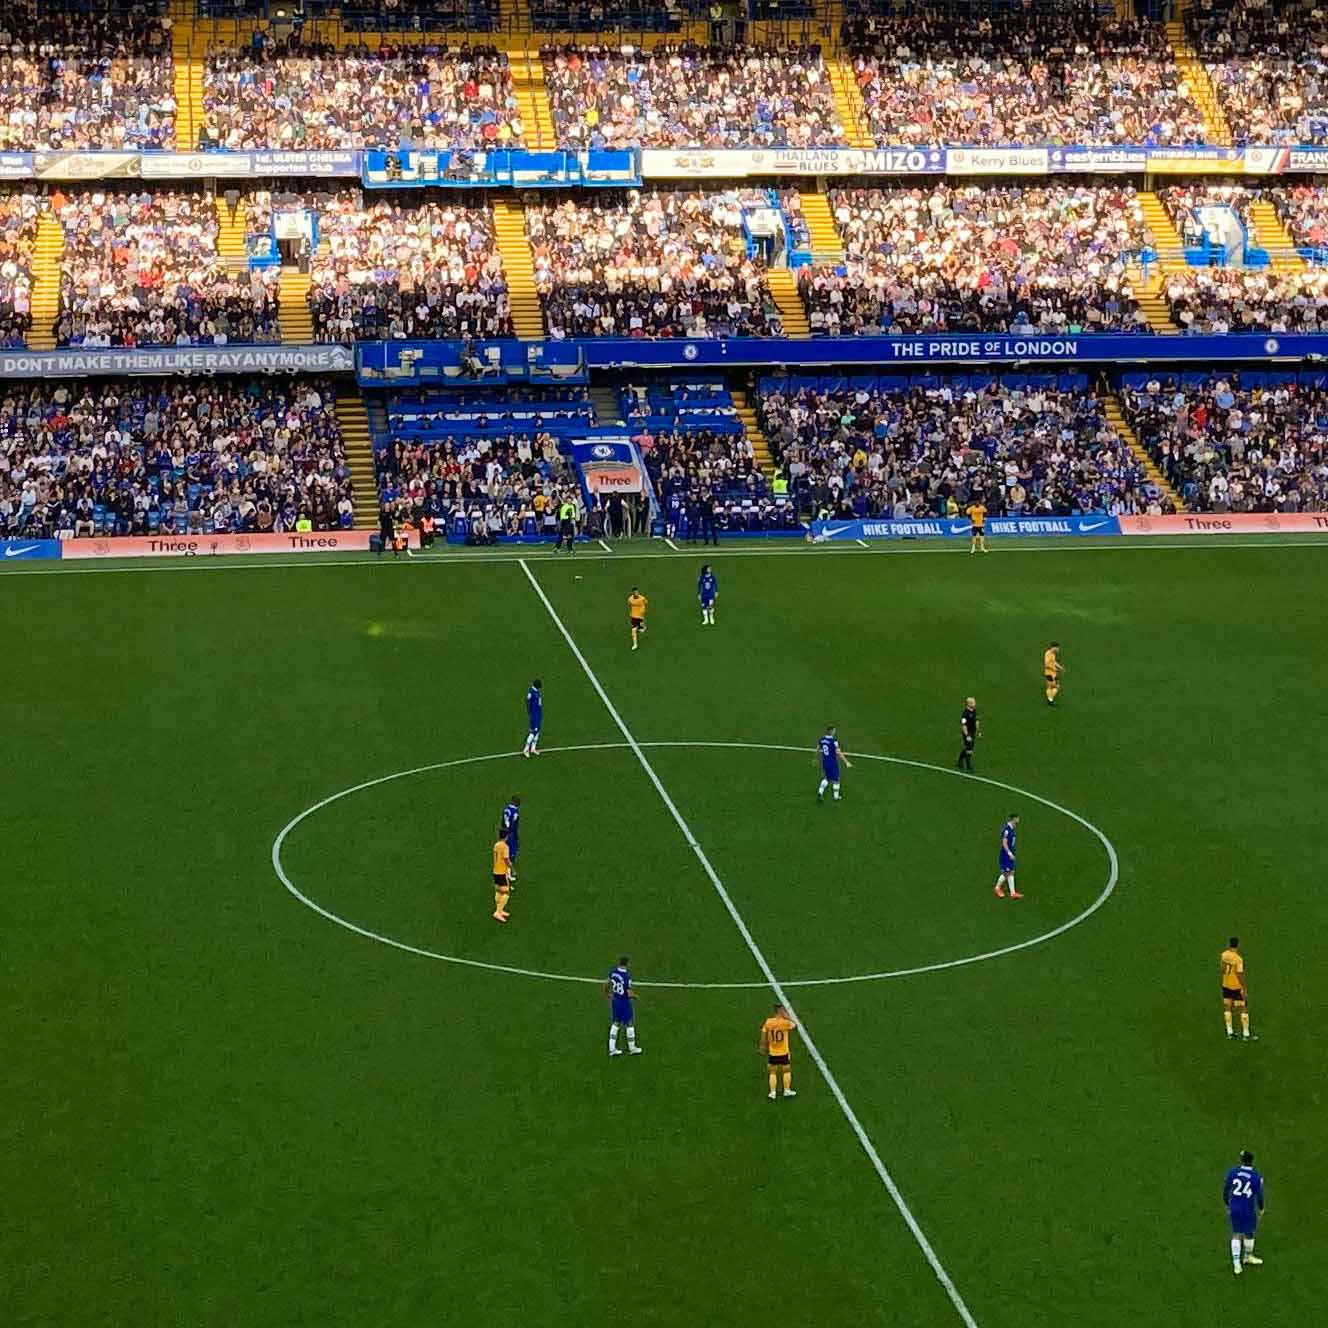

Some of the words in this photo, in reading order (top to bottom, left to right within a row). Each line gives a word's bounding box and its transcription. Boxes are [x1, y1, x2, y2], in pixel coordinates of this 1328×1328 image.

[309, 153, 352, 163] CHELSEA
[774, 150, 839, 162] THAILAND
[863, 151, 926, 172] MIZO
[971, 151, 1006, 169] Kerry
[1008, 150, 1045, 166] Blues
[799, 161, 839, 172] BLUES
[891, 343, 924, 357] THE
[929, 342, 980, 357] PRIDE
[984, 341, 1001, 354] OF
[1005, 341, 1077, 356] LONDON
[59, 355, 112, 371] MAKE
[113, 354, 163, 369] THEM
[165, 353, 204, 368] LIKE
[206, 352, 242, 367] RAY
[242, 351, 330, 367] ANYMORE
[598, 475, 631, 486] Three
[863, 523, 889, 536] NIKE
[891, 522, 944, 535] FOOTBALL
[991, 521, 1016, 533] NIKE
[1018, 520, 1072, 533] FOOTBALL
[1184, 517, 1232, 530] Three
[147, 539, 198, 553] Three
[287, 535, 338, 549] Three
[610, 979, 625, 996] 28
[770, 1029, 785, 1044] 10
[1232, 1178, 1253, 1199] 24
